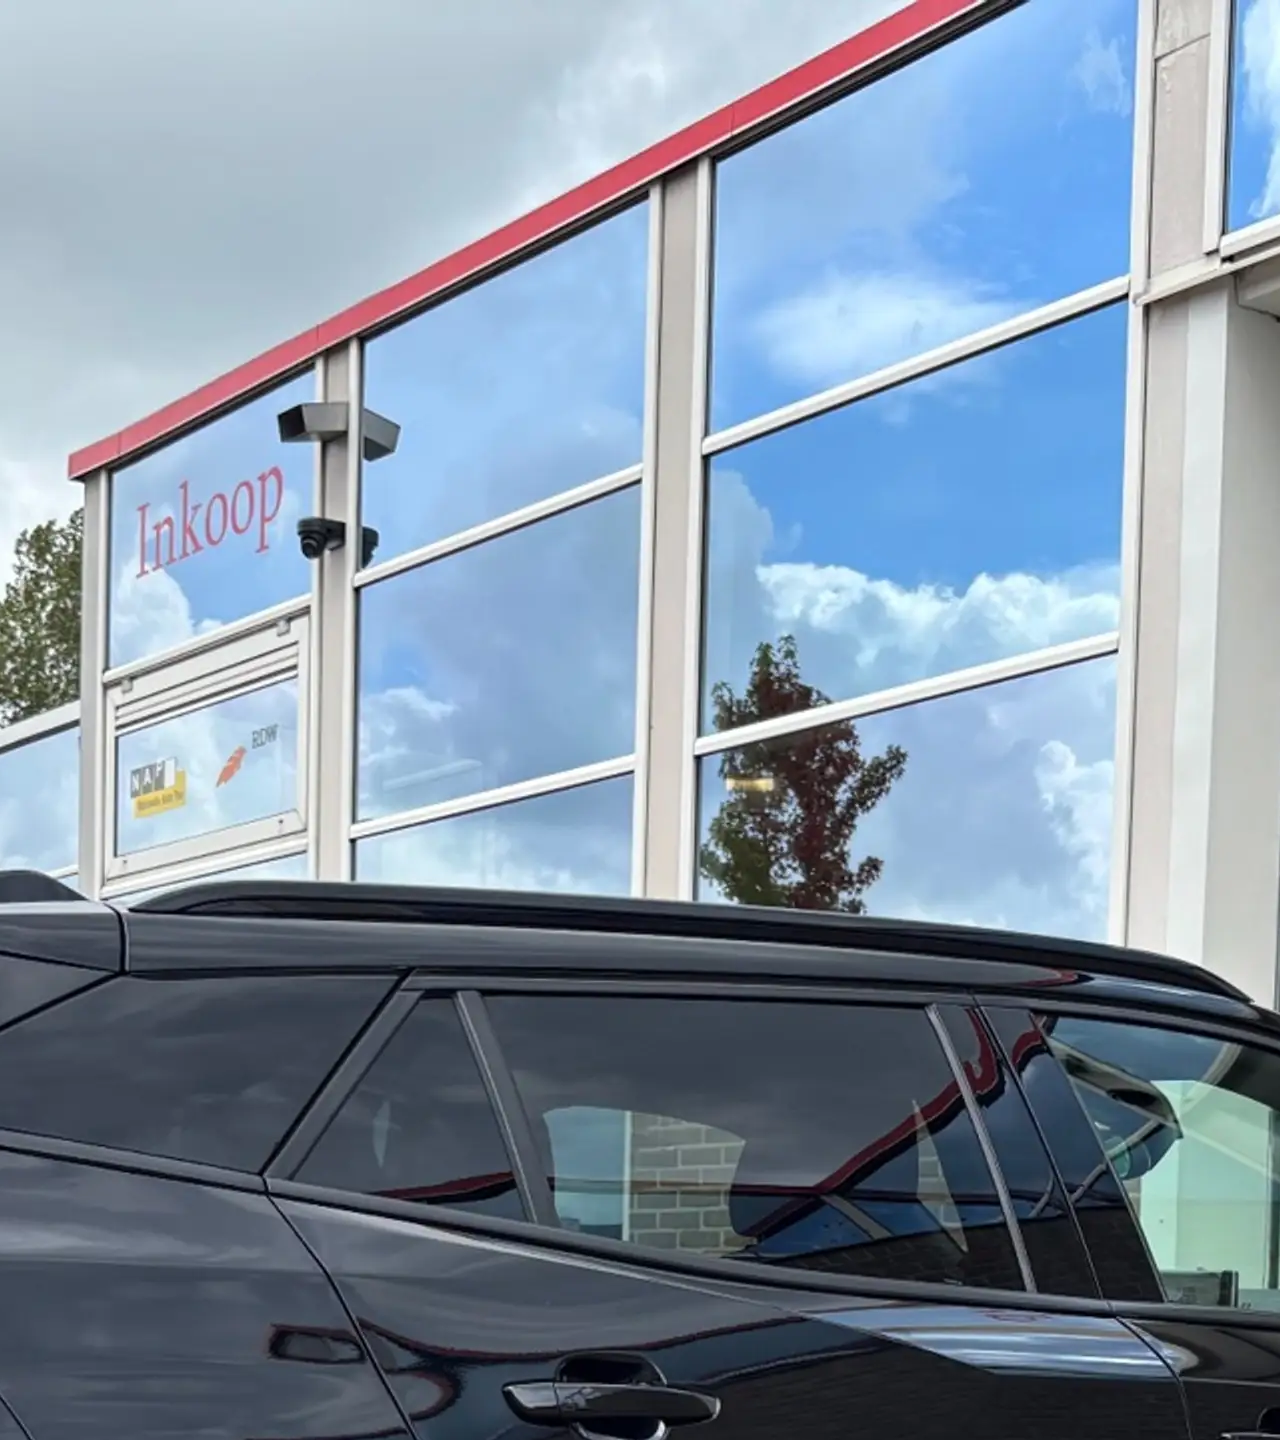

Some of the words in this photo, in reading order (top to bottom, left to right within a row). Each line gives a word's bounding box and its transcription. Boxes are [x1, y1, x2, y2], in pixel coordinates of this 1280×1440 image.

[136, 466, 284, 579] Inkoop
[251, 724, 279, 749] RDW
[131, 760, 171, 795] NAP
